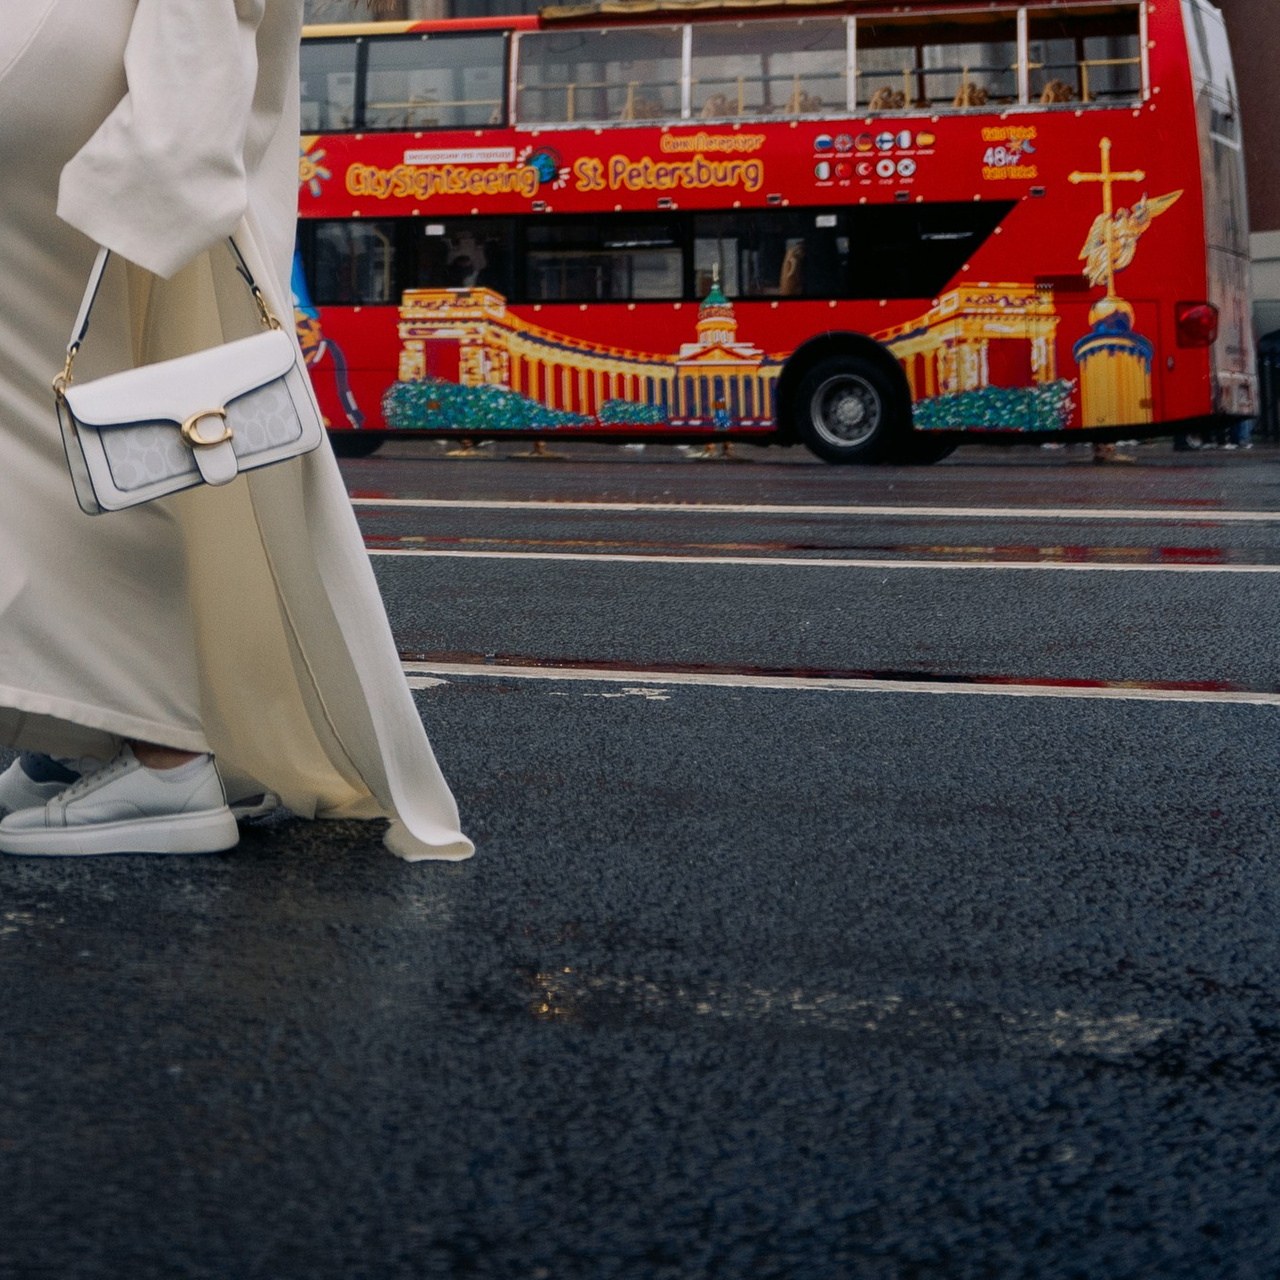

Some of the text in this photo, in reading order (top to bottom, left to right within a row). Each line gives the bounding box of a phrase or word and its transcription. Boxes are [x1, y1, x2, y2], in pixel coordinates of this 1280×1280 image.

[346, 153, 764, 200] CitySightseeing St Petersburg
